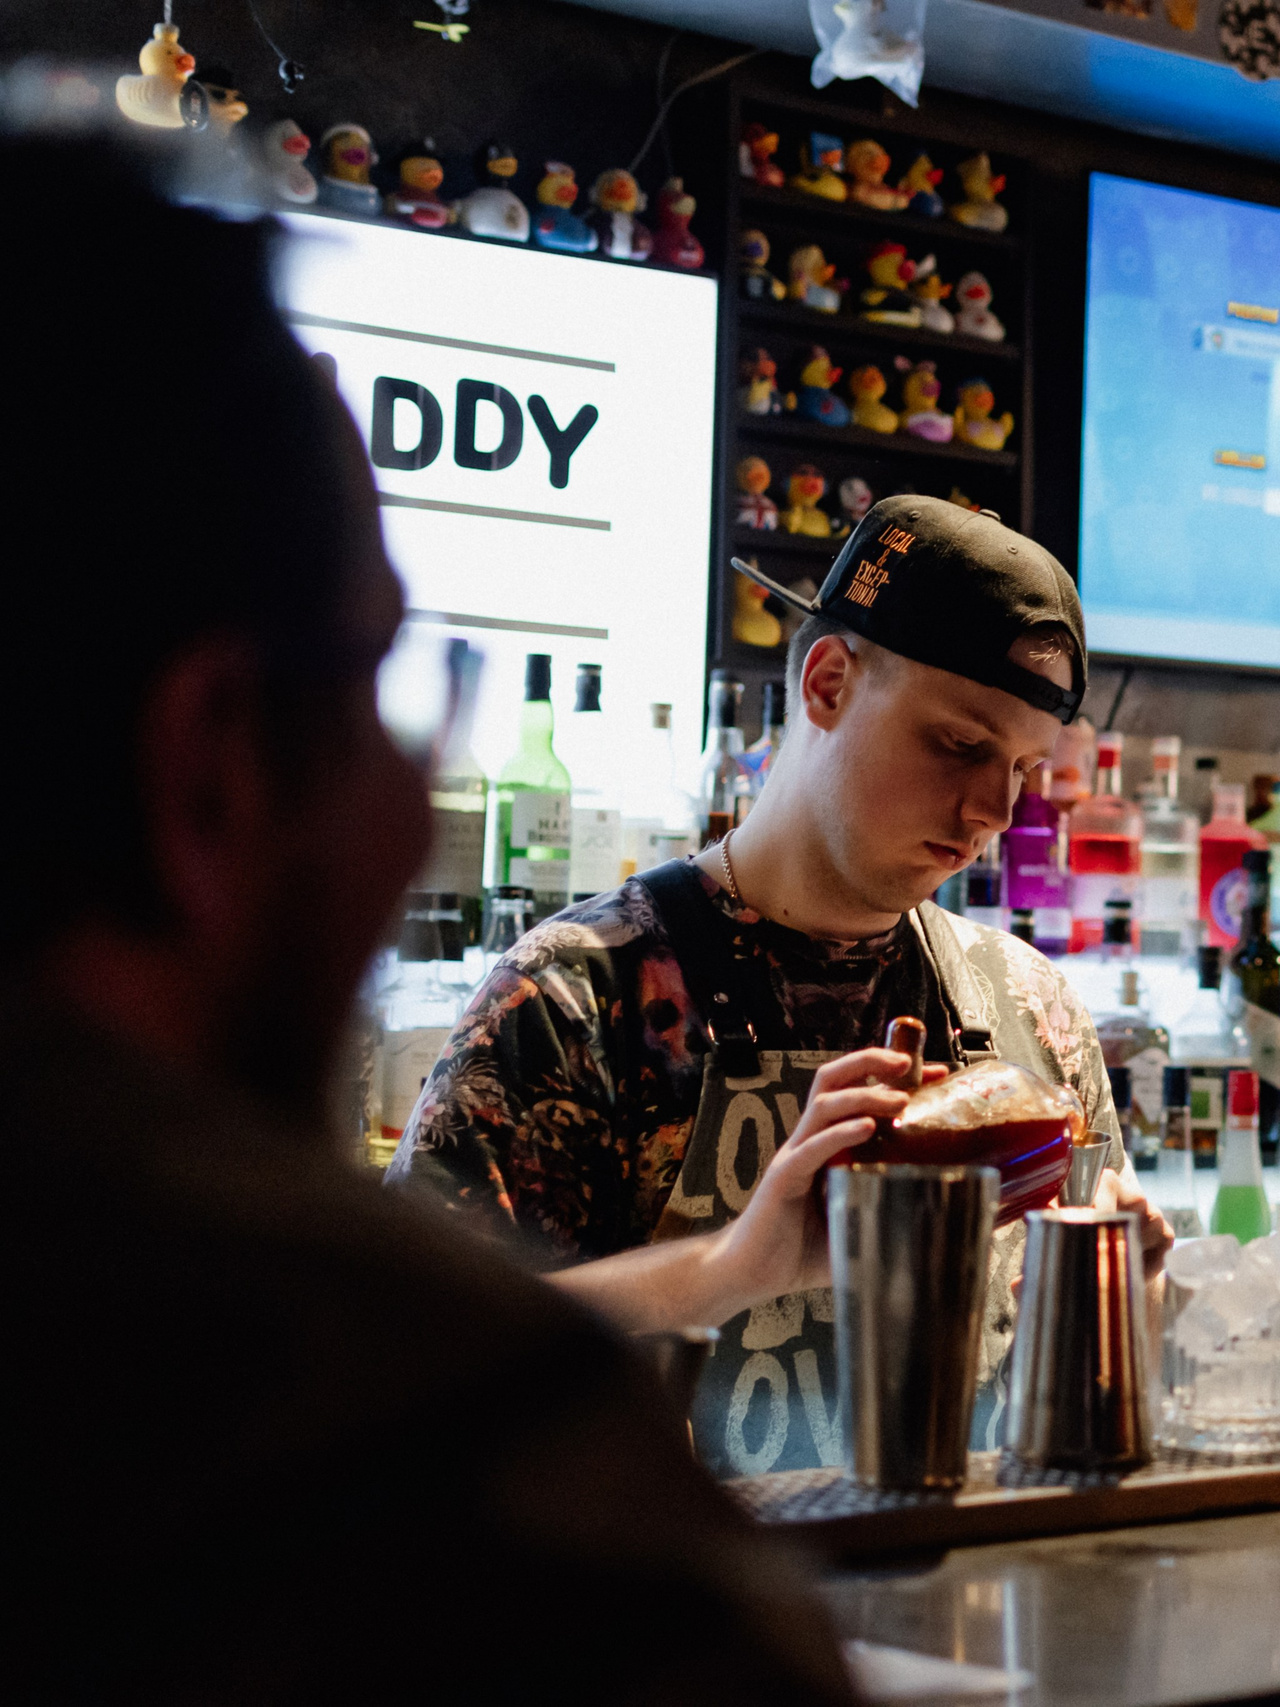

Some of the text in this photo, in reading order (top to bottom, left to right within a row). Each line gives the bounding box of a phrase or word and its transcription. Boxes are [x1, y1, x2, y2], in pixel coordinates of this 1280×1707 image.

[312, 352, 599, 489] DDY
[878, 523, 916, 554] LOCAL
[876, 548, 892, 567] &
[854, 559, 890, 589] EXCEP-
[843, 579, 880, 608] TIONAL
